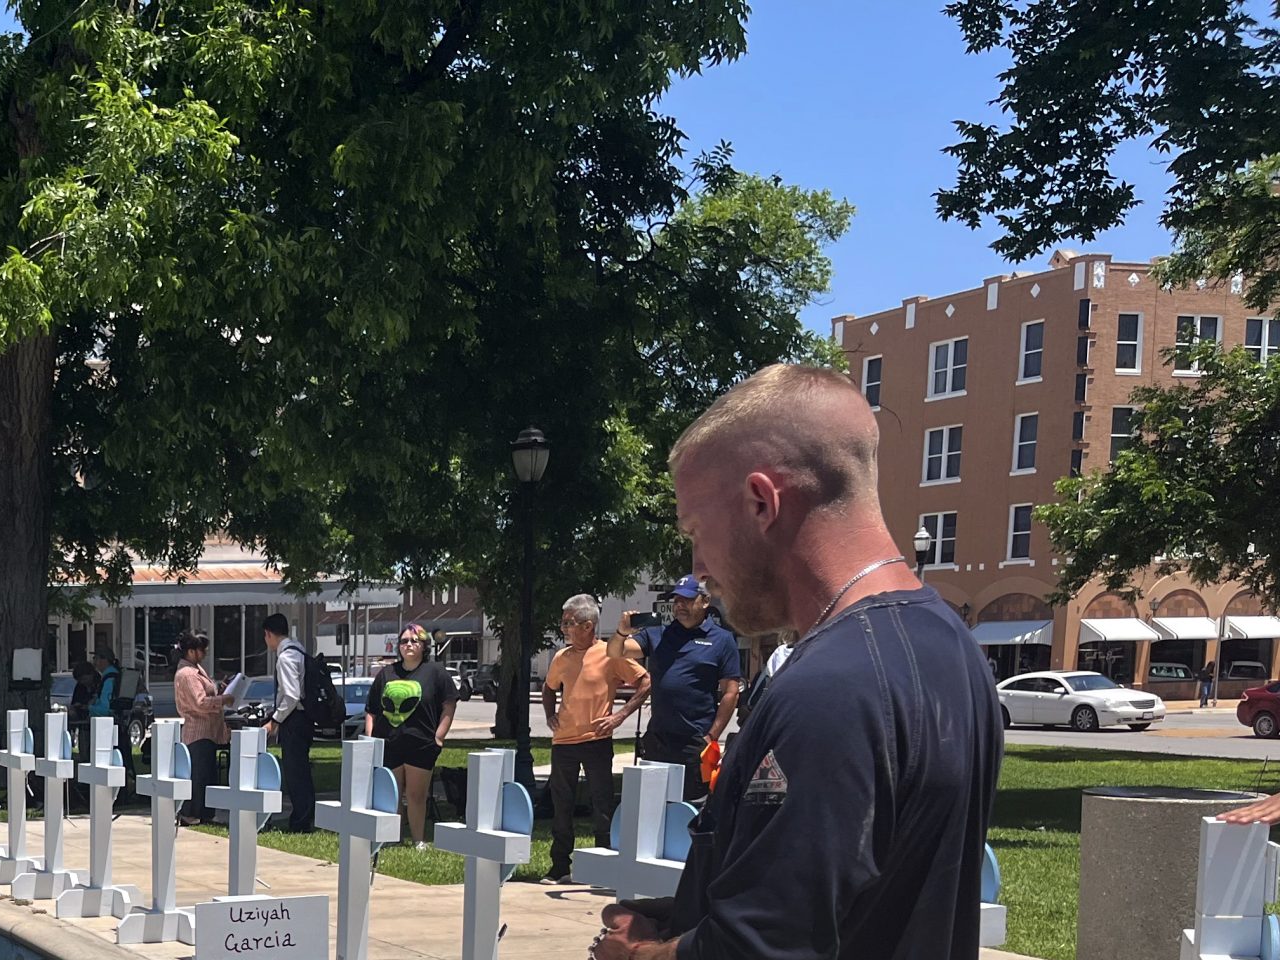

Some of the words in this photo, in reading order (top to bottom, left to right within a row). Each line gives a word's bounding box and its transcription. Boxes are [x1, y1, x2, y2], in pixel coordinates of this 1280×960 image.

[679, 577, 689, 586] T
[660, 604, 672, 613] ON
[229, 902, 291, 927] Uziyah
[224, 931, 297, 953] Garcia
